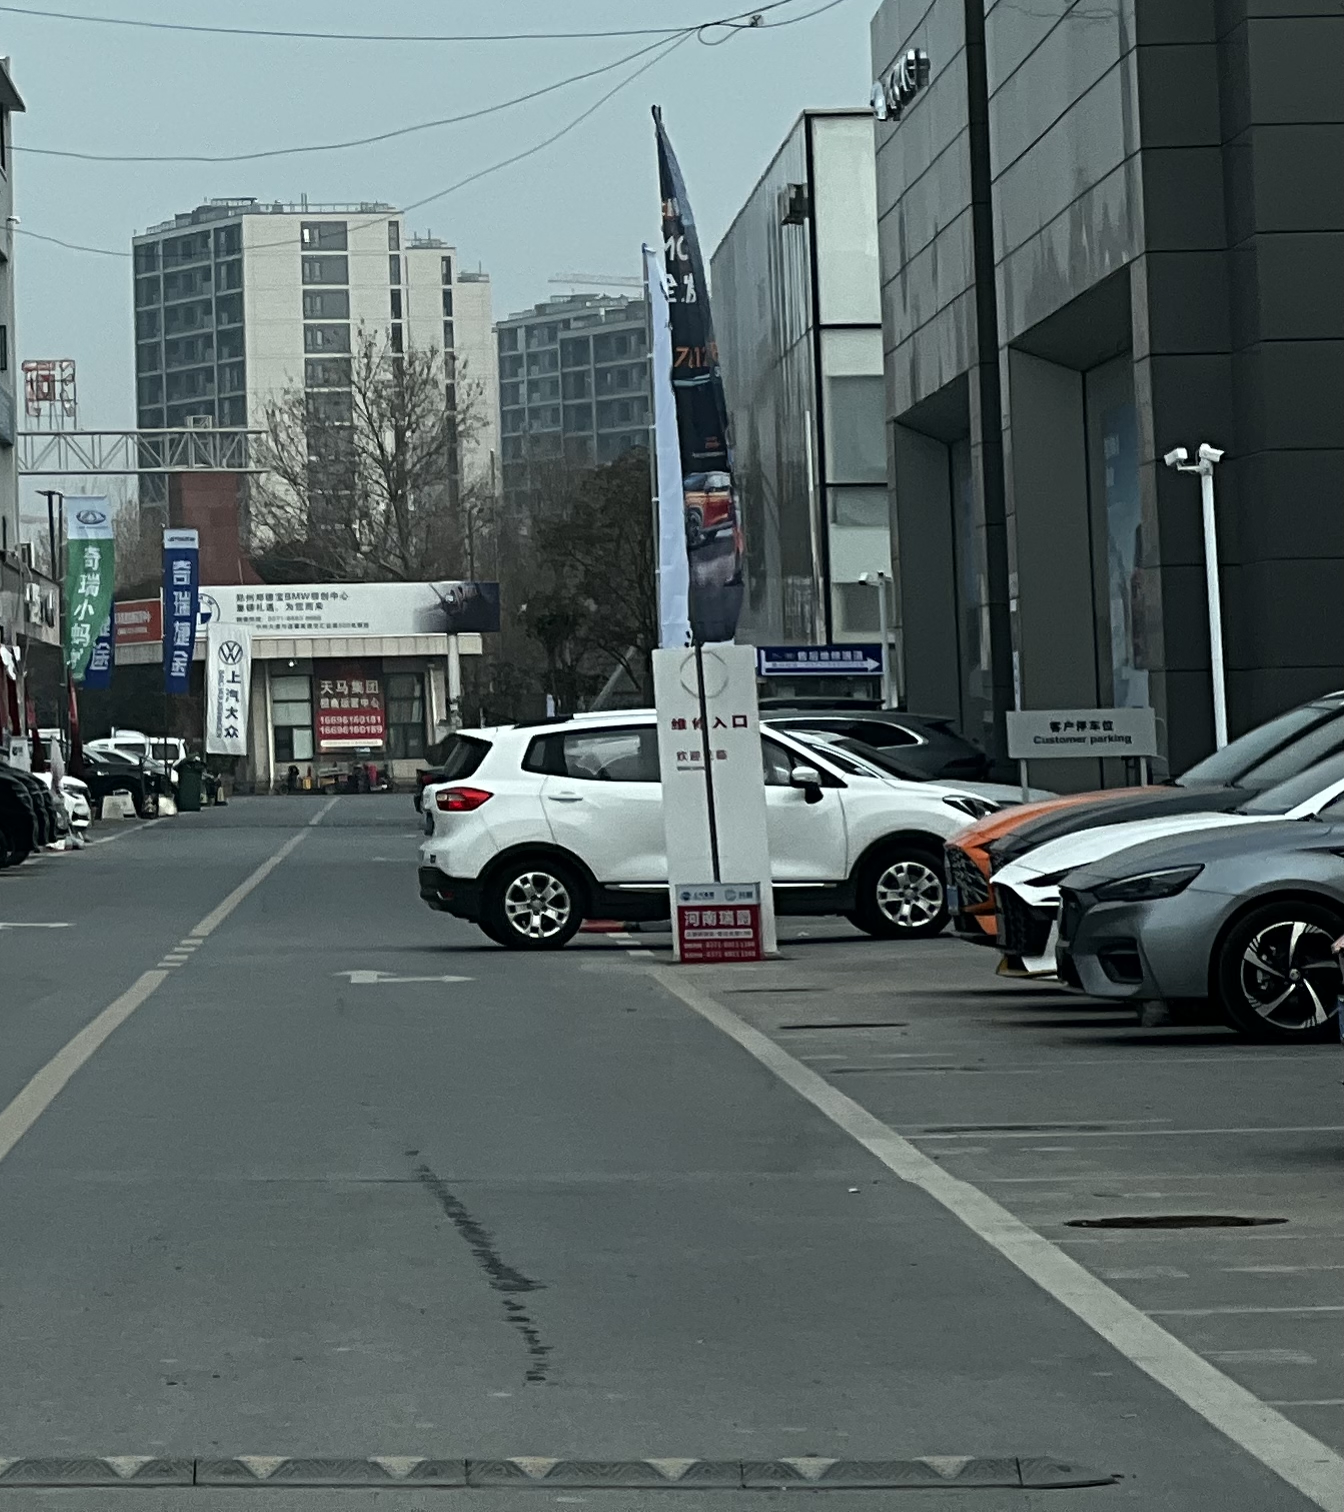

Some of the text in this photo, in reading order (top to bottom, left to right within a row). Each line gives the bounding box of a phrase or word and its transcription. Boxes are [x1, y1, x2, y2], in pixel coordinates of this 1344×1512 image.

[320, 679, 379, 695] 天马集团
[224, 670, 242, 739] 上汽大众
[1033, 733, 1133, 745] Customer parking
